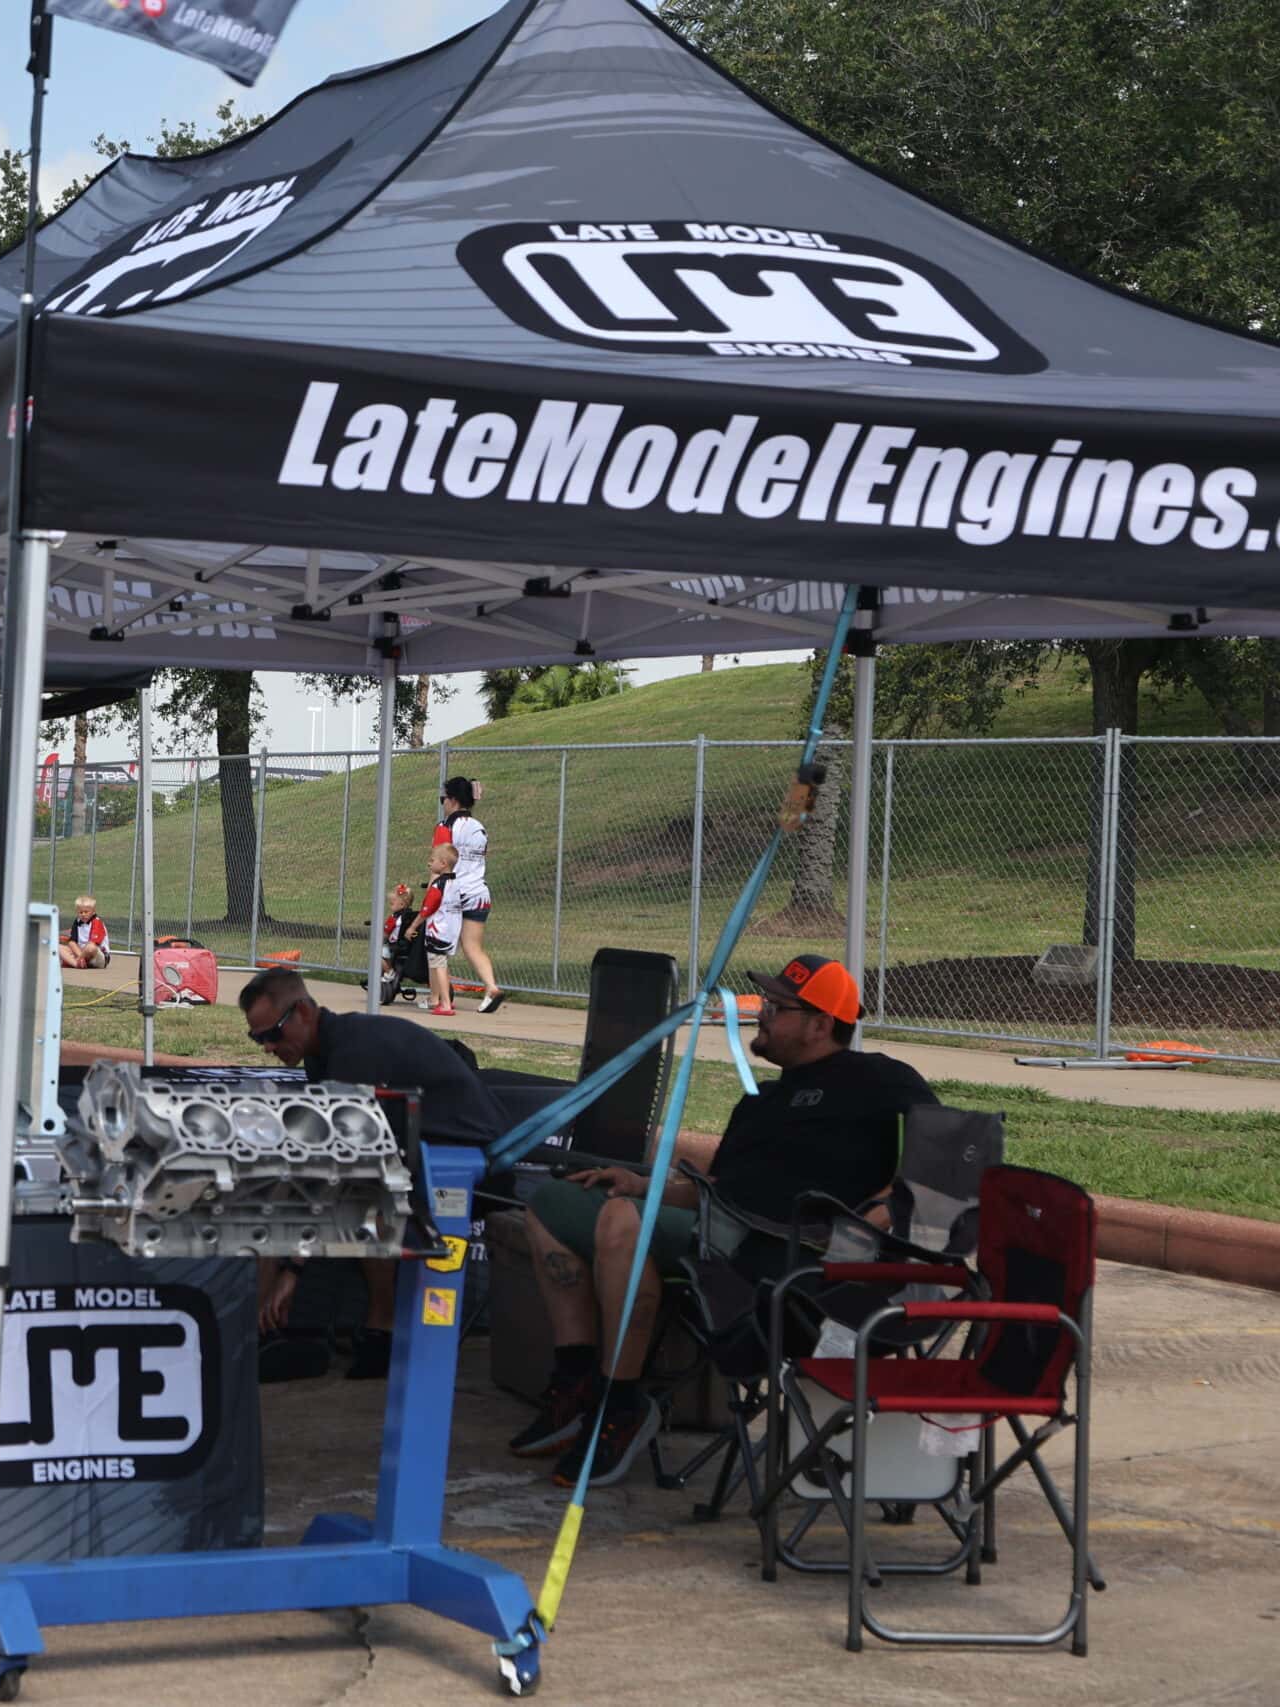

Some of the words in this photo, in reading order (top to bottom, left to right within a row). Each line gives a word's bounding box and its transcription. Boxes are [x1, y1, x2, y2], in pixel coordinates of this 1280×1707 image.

[549, 223, 659, 242] LATE
[691, 223, 841, 251] MODEL
[707, 342, 913, 366] ENGINES
[277, 380, 1280, 551] LateModelEngines.
[74, 1288, 162, 1308] MODEL
[31, 1457, 136, 1484] ENGINES
